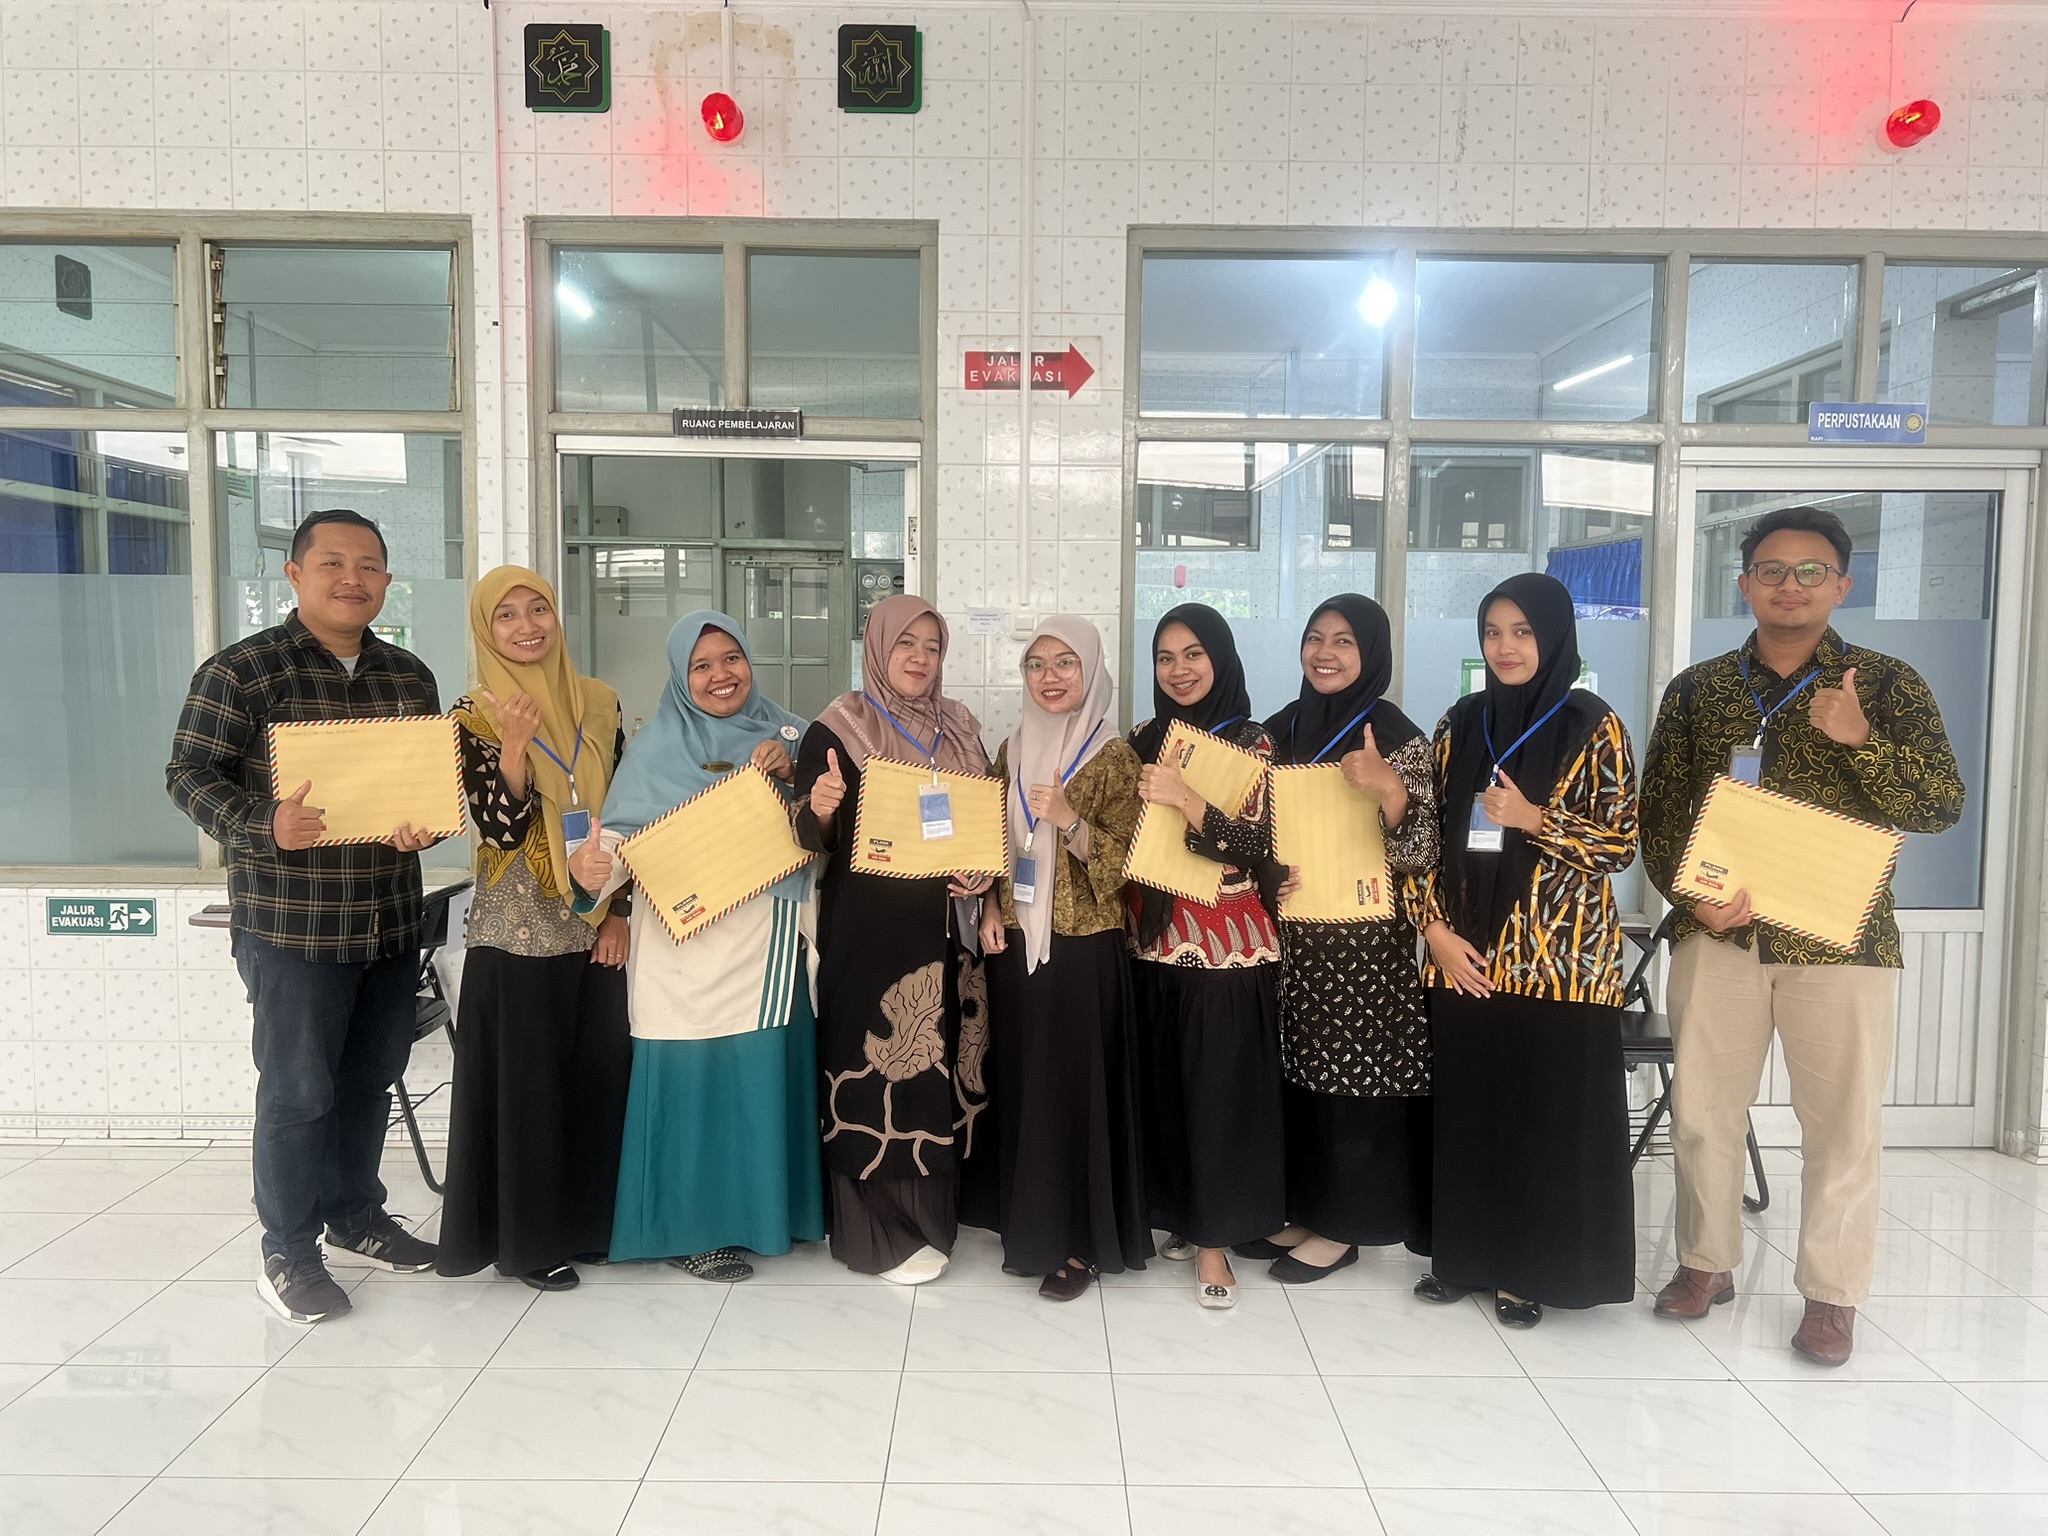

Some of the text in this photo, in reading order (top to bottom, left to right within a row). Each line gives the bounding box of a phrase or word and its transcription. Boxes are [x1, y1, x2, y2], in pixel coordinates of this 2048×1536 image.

[986, 355, 1044, 367] JALR
[969, 370, 1062, 382] EVAKASI
[682, 419, 795, 430] RUANG PEMBELAJARAN
[1817, 412, 1901, 429] PERPUSTAKAAN
[60, 905, 95, 915] JALUR
[51, 917, 104, 927] EVAKUASI
